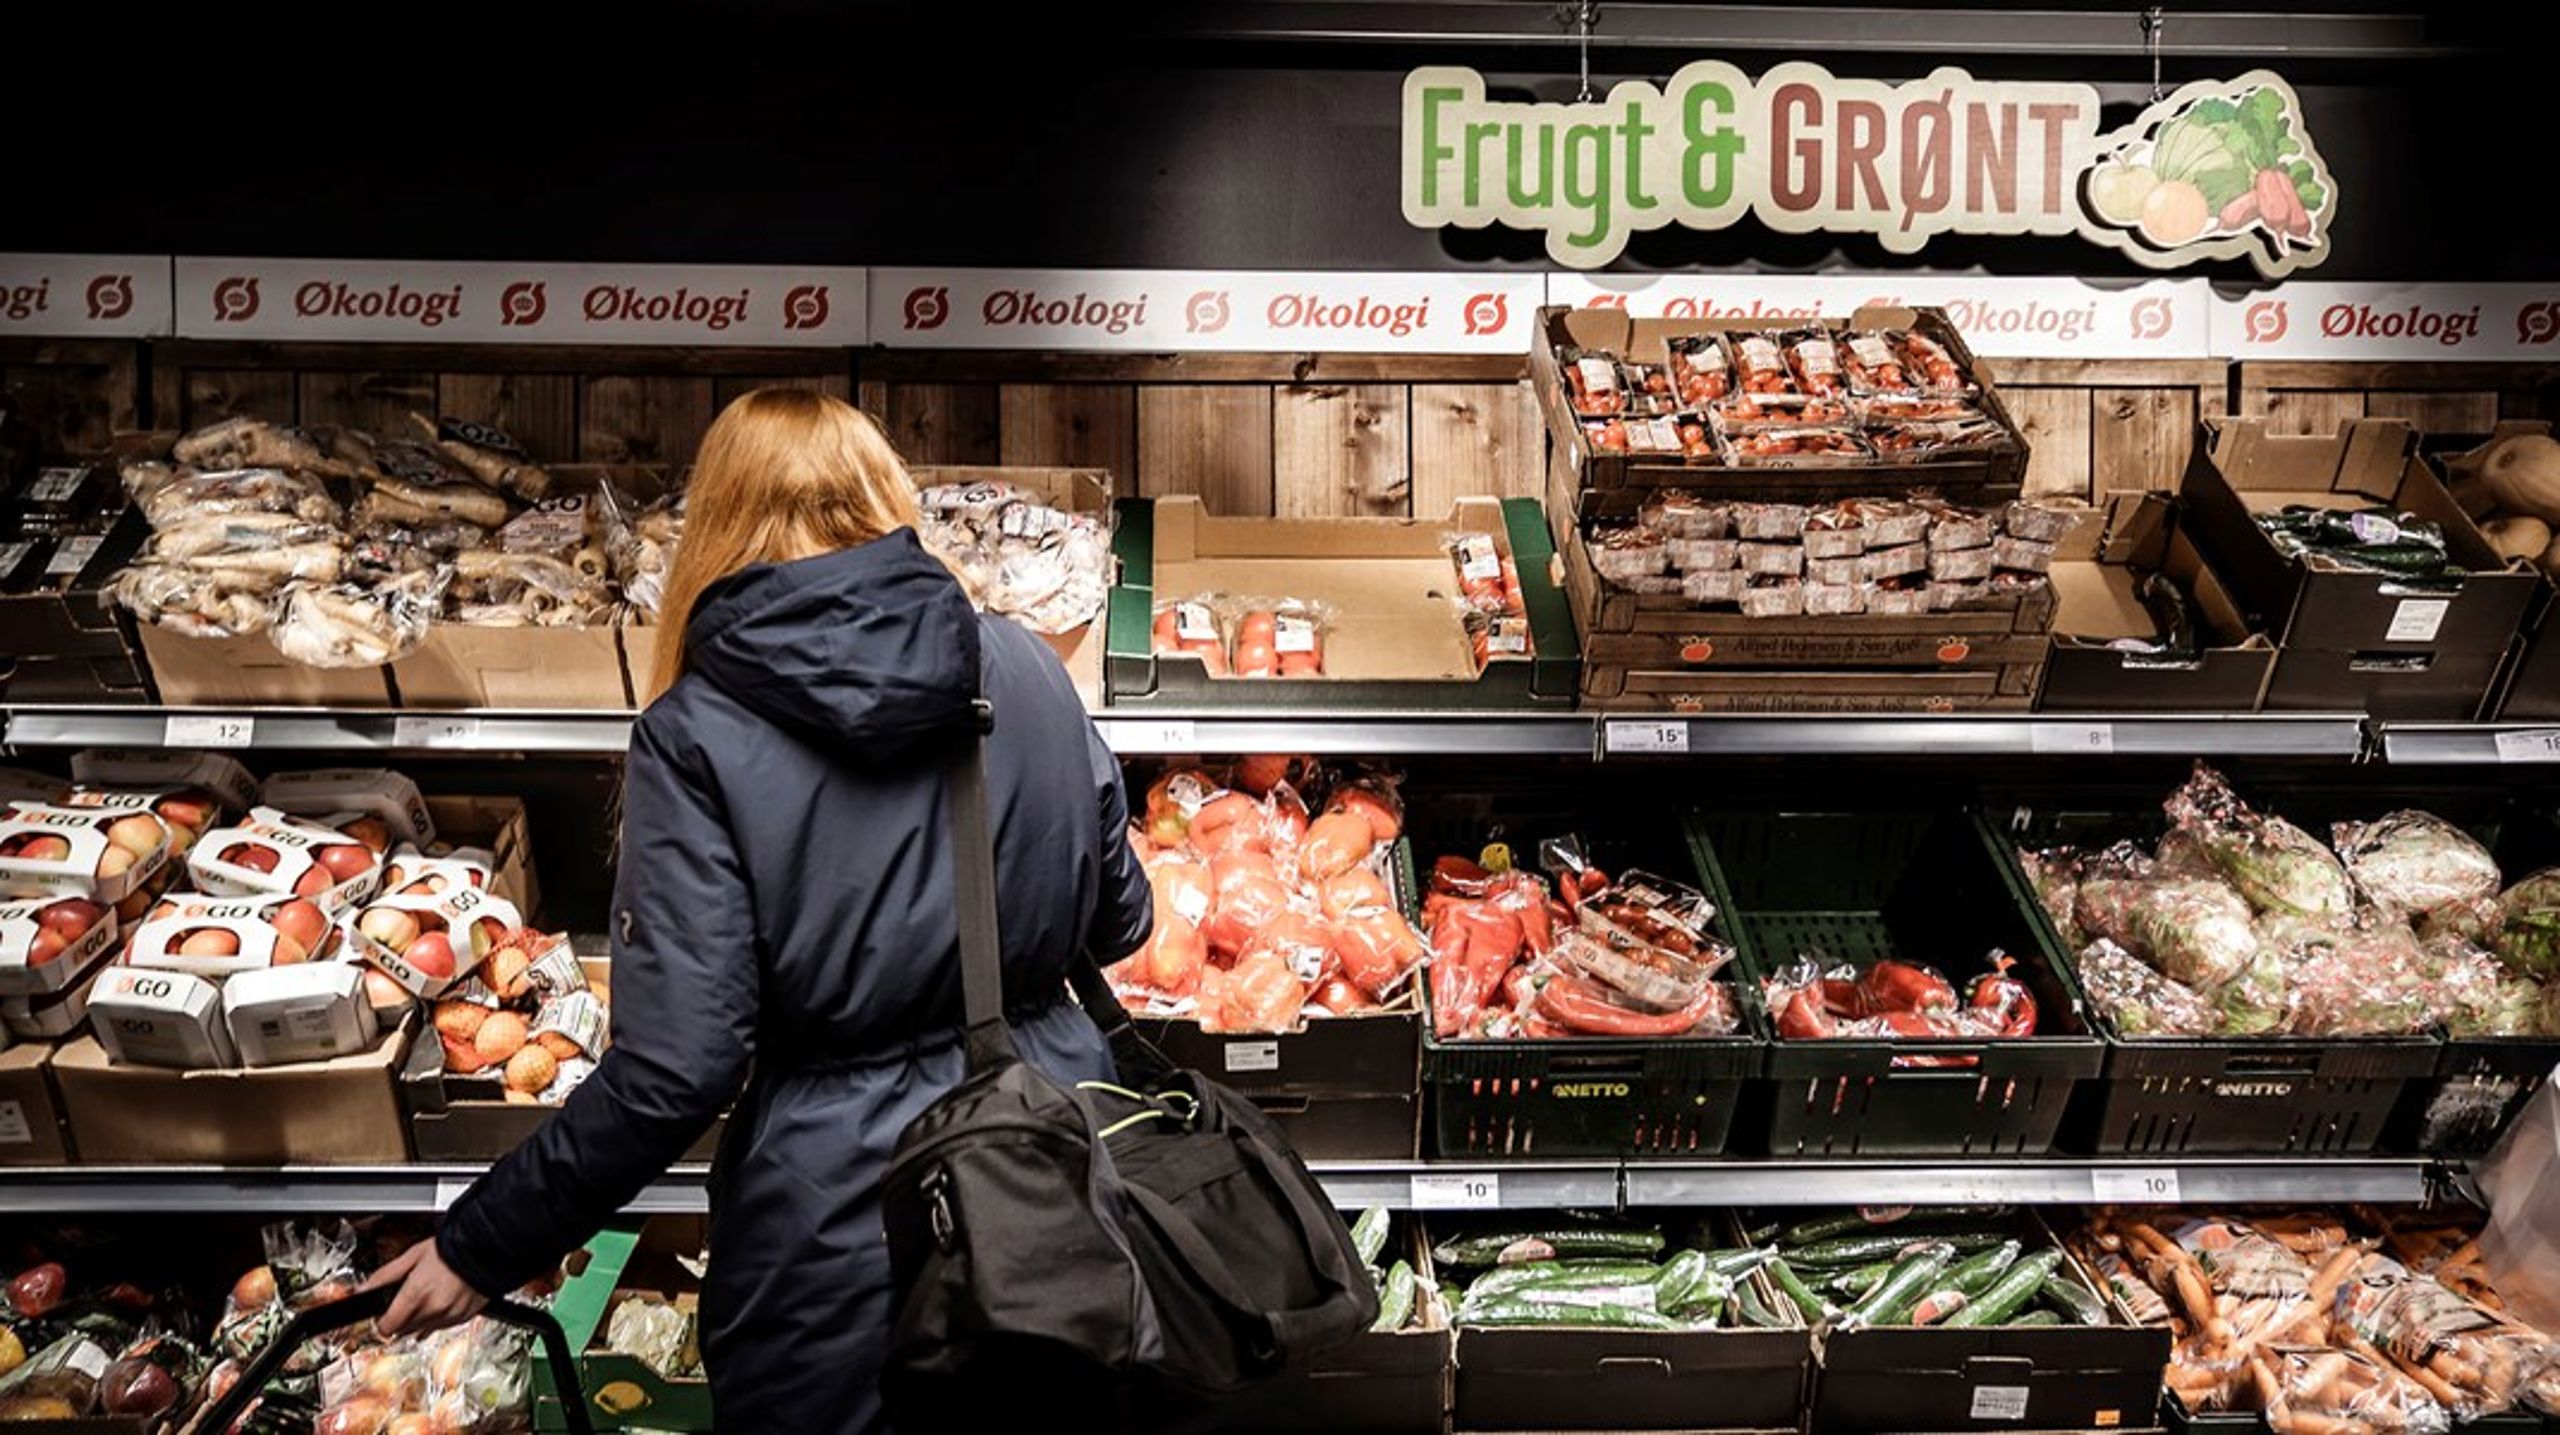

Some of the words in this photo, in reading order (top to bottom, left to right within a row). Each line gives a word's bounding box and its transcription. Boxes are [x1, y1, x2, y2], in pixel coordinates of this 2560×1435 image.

[1421, 88, 1658, 247] Frugt
[1681, 81, 1745, 208] &
[1771, 83, 2080, 232] GRØNT
[294, 281, 463, 327] Økologi
[582, 284, 750, 331] Økologi
[982, 288, 1148, 335] Økologi
[1267, 294, 1430, 337] Økologi
[2320, 304, 2482, 346] Økologi
[219, 724, 240, 738] 12
[1656, 728, 1679, 742] 15
[82, 793, 145, 808] ØGO
[23, 811, 90, 828] ØGO
[252, 824, 309, 847] ØGO
[184, 904, 252, 919] ØGO
[116, 976, 172, 998] ØGO
[1563, 1082, 1630, 1098] NETTO
[1464, 1182, 1487, 1198] 10
[2144, 1178, 2167, 1193] 10
